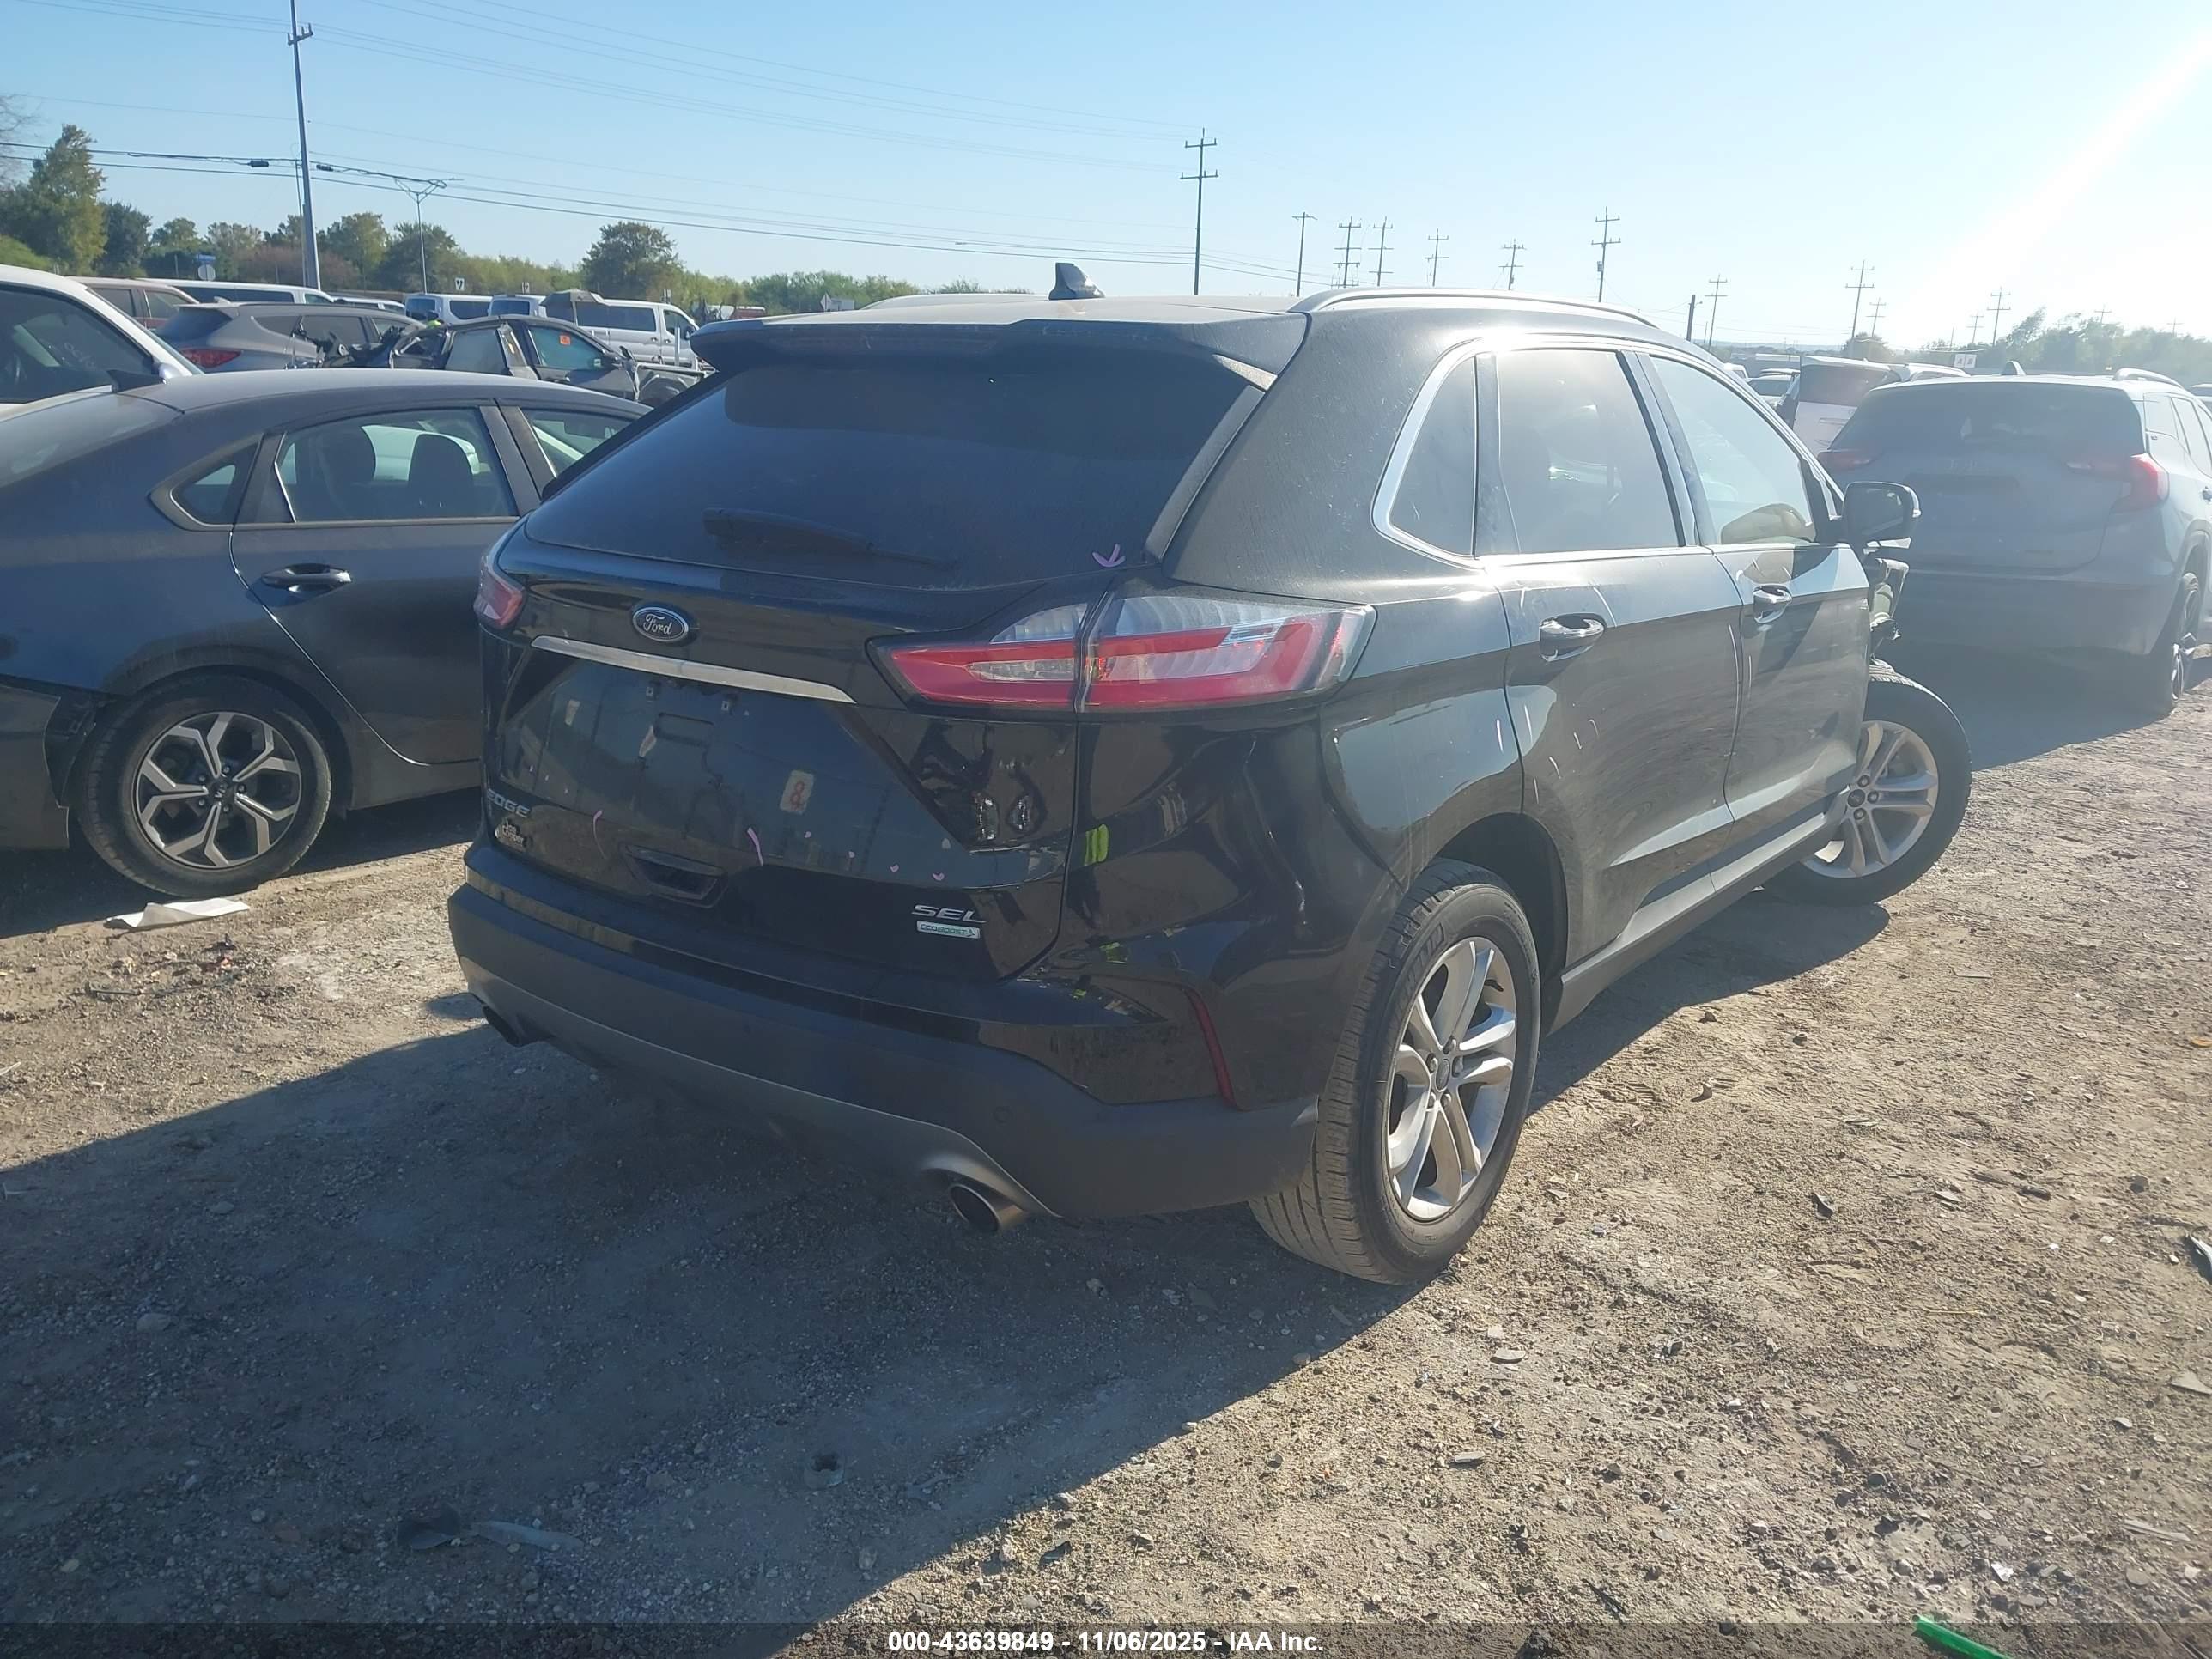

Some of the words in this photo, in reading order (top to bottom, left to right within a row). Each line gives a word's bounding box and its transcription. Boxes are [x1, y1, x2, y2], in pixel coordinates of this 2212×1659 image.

[643, 614, 673, 635] Ford
[487, 788, 531, 818] EDGE
[911, 904, 988, 923] SEL
